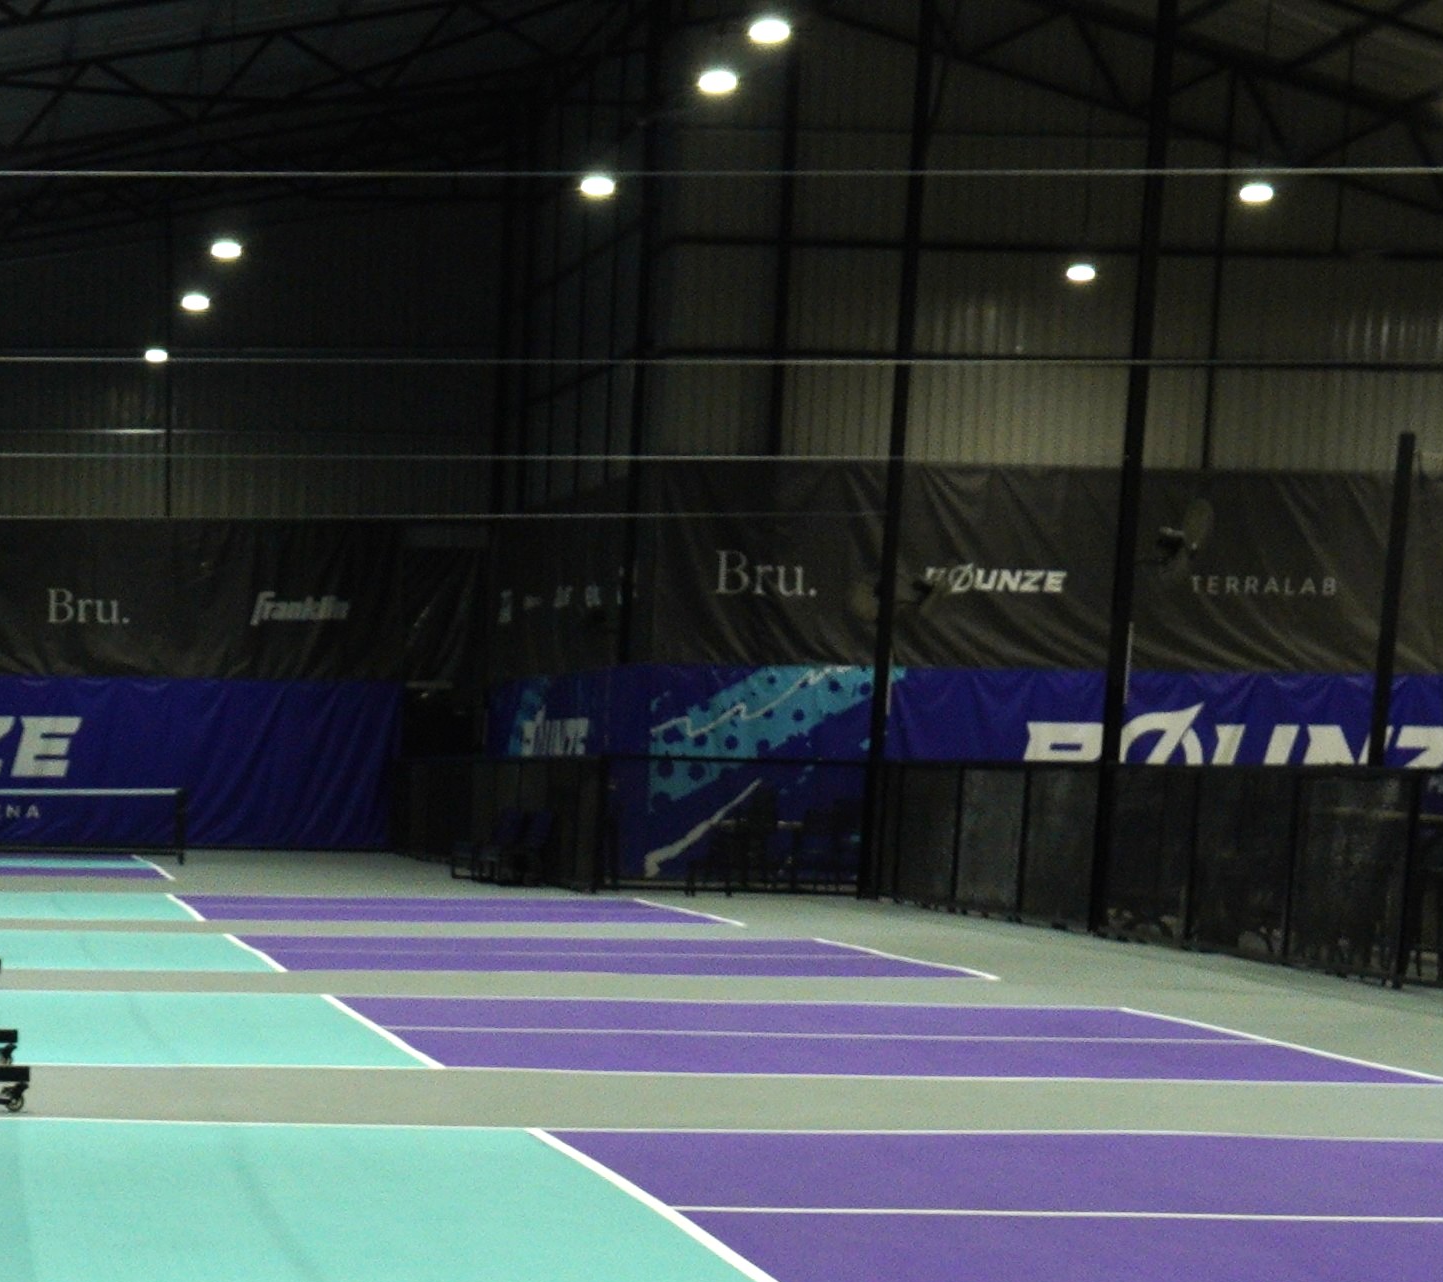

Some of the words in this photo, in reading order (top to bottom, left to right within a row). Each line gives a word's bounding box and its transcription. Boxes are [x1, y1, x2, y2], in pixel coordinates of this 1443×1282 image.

[717, 549, 818, 596] Bru.
[1190, 574, 1337, 597] TERRALAB
[47, 588, 130, 625] Bru.
